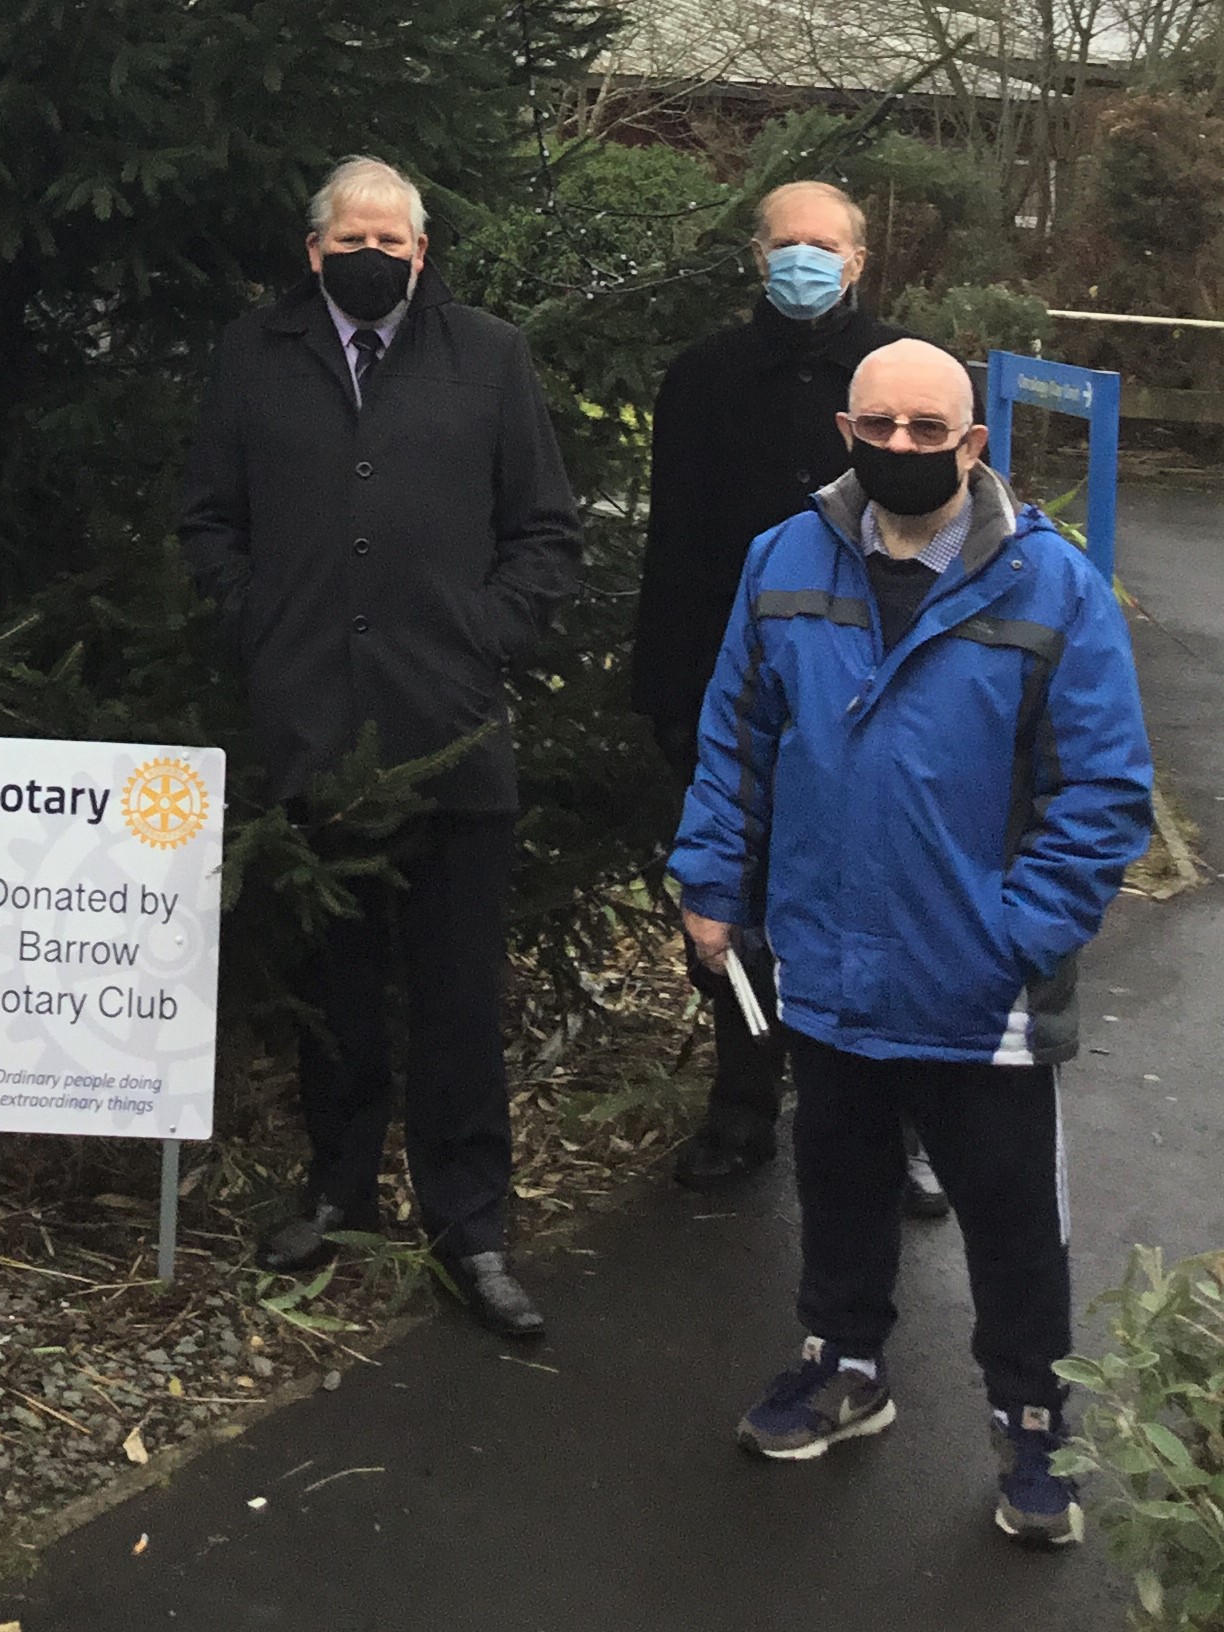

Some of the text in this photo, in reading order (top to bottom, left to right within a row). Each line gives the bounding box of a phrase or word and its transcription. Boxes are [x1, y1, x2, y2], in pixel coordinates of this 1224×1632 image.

[140, 883, 179, 925] by
[18, 930, 140, 967] Barrow
[98, 985, 178, 1021] Club
[63, 1072, 116, 1091] people
[118, 1073, 163, 1095] doing
[0, 1093, 155, 1116] extraordinary things
